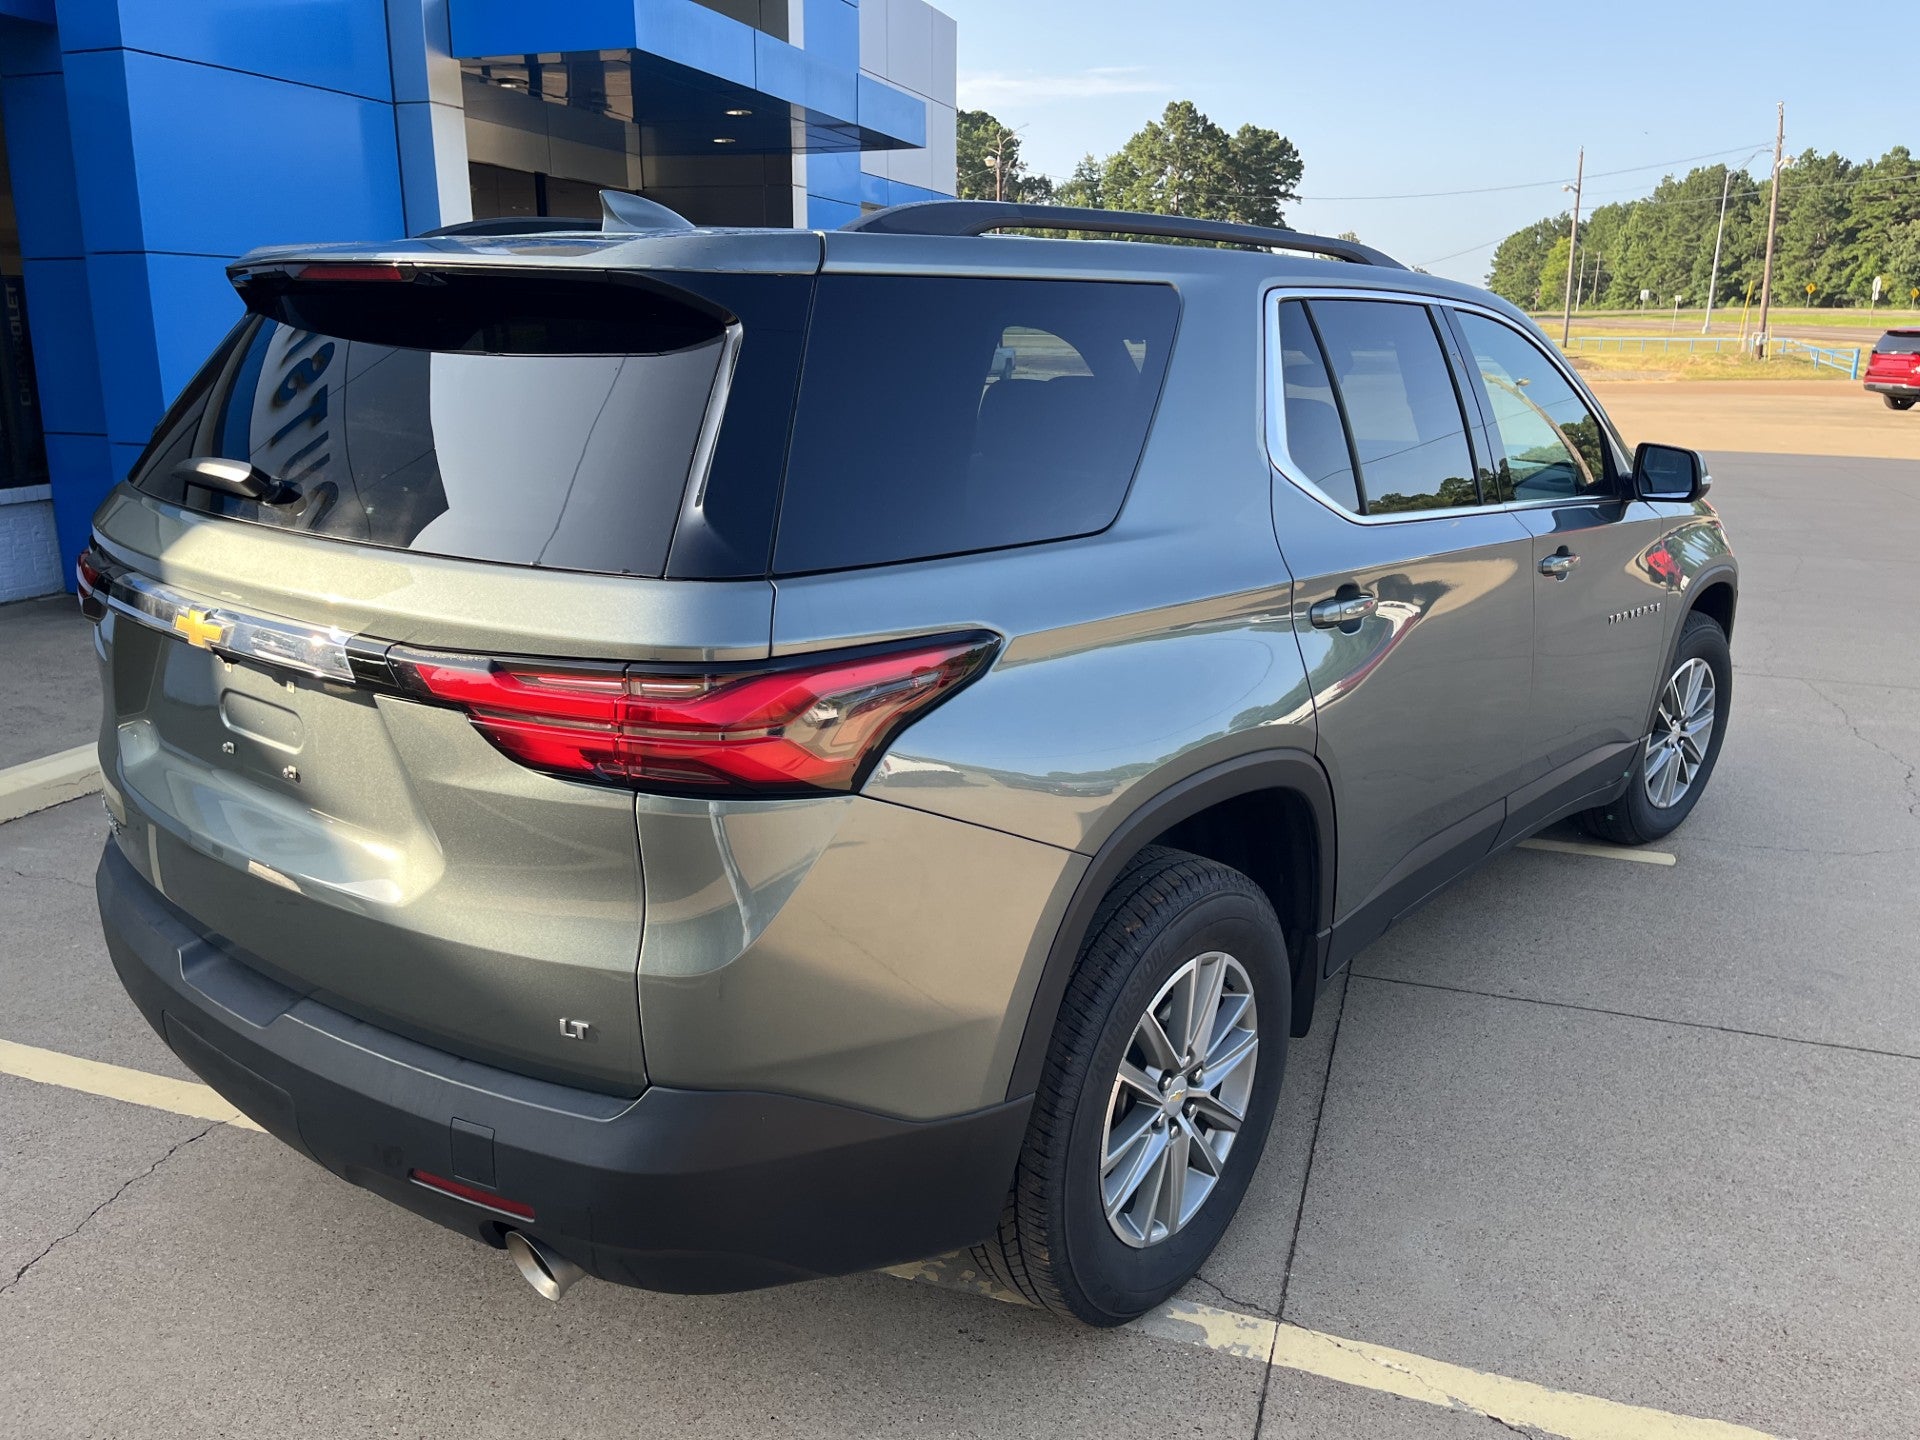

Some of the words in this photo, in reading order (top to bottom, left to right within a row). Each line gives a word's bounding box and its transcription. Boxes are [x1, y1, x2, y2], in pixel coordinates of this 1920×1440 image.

[6, 285, 32, 406] CHEVROLET
[1608, 602, 1661, 625] TRAVERSE
[559, 1017, 590, 1040] LT
